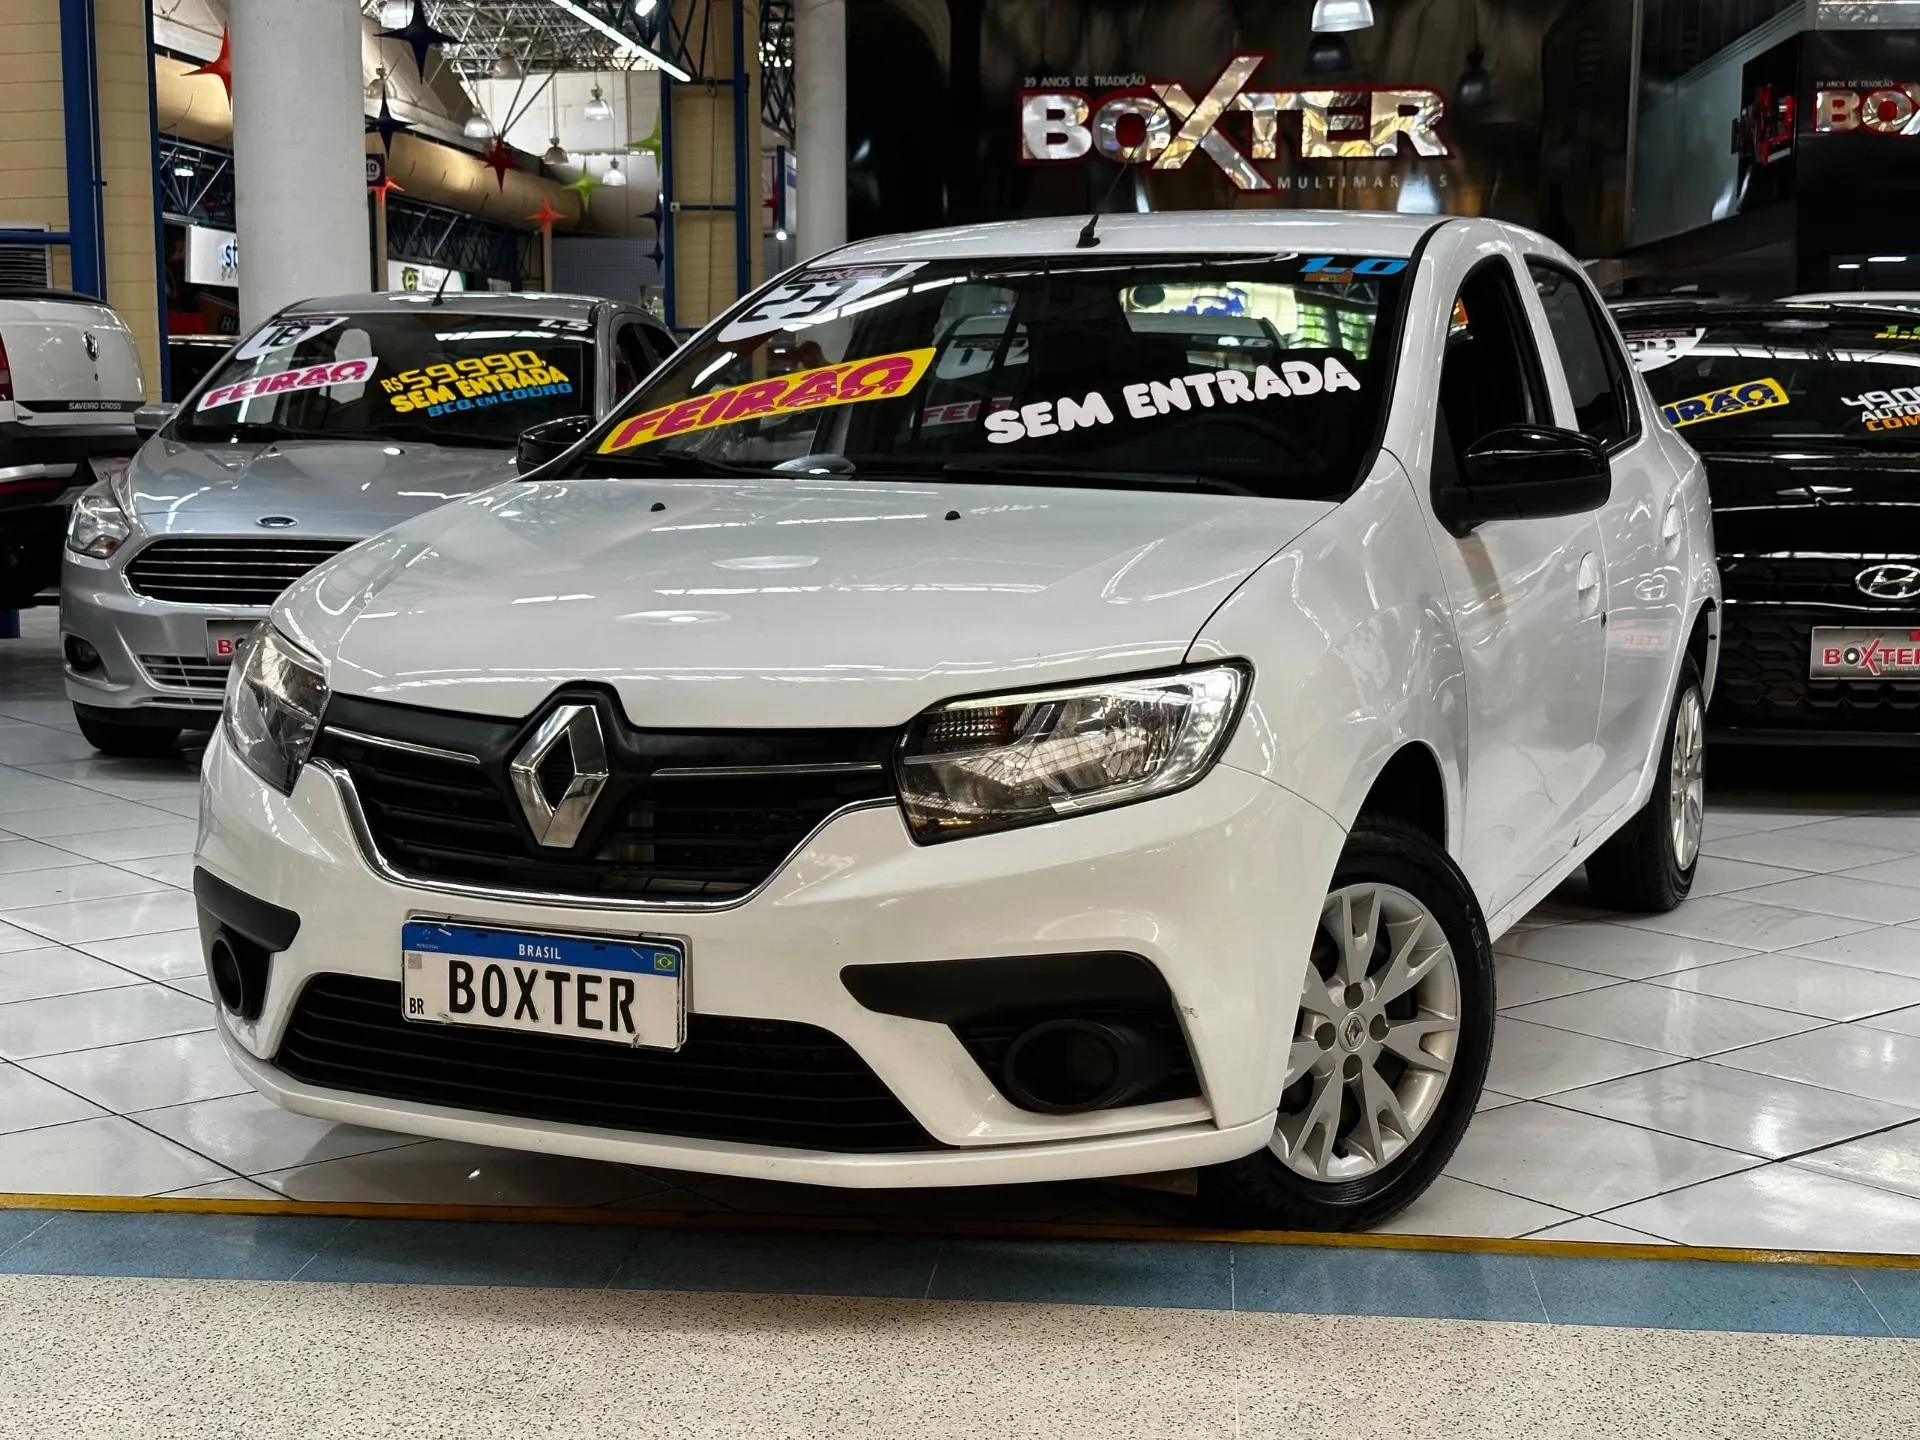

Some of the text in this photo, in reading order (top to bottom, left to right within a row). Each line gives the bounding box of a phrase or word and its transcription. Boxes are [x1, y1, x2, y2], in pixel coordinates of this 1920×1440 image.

[1023, 74, 1146, 88] 39 ANOS DE TRADIÇÃO
[1826, 79, 1846, 88] ANOS
[1020, 55, 1451, 191] BOXTER
[1277, 174, 1448, 189] MULTIMARAS
[1299, 256, 1409, 275] 1.0
[390, 366, 569, 412] SEM ENTRADA
[500, 383, 573, 402] COURO
[69, 402, 122, 410] SAVEIRO CROSS
[611, 356, 914, 448] FEIRÃO
[984, 356, 1361, 444] SEM ENTRADA
[518, 944, 562, 960] BRASIL
[409, 997, 425, 1015] BR
[449, 959, 636, 1034] BOXTER
